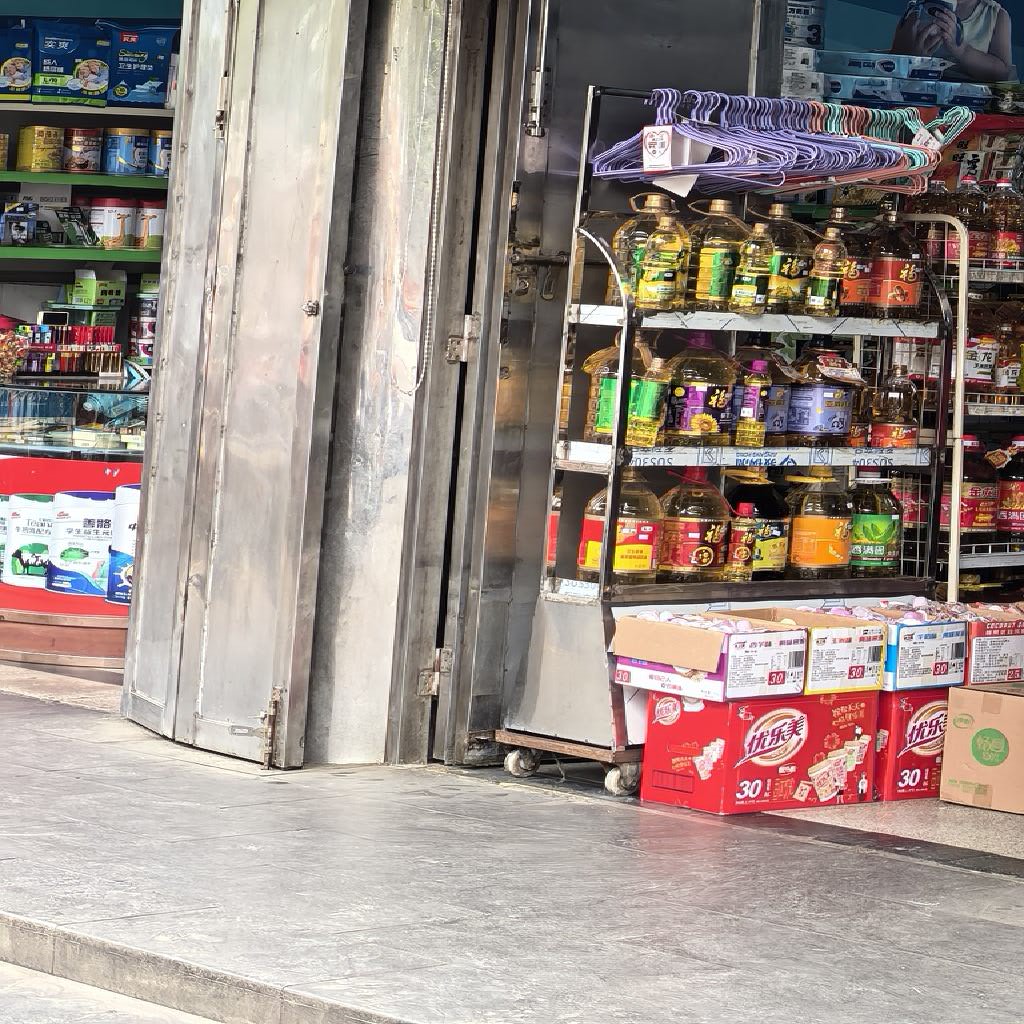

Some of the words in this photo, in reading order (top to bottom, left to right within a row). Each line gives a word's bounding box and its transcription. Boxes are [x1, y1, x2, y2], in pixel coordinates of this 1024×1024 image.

[747, 715, 805, 755] 优乐美
[907, 714, 947, 744] 优乐
[735, 779, 762, 799] 30
[898, 768, 921, 788] 30
